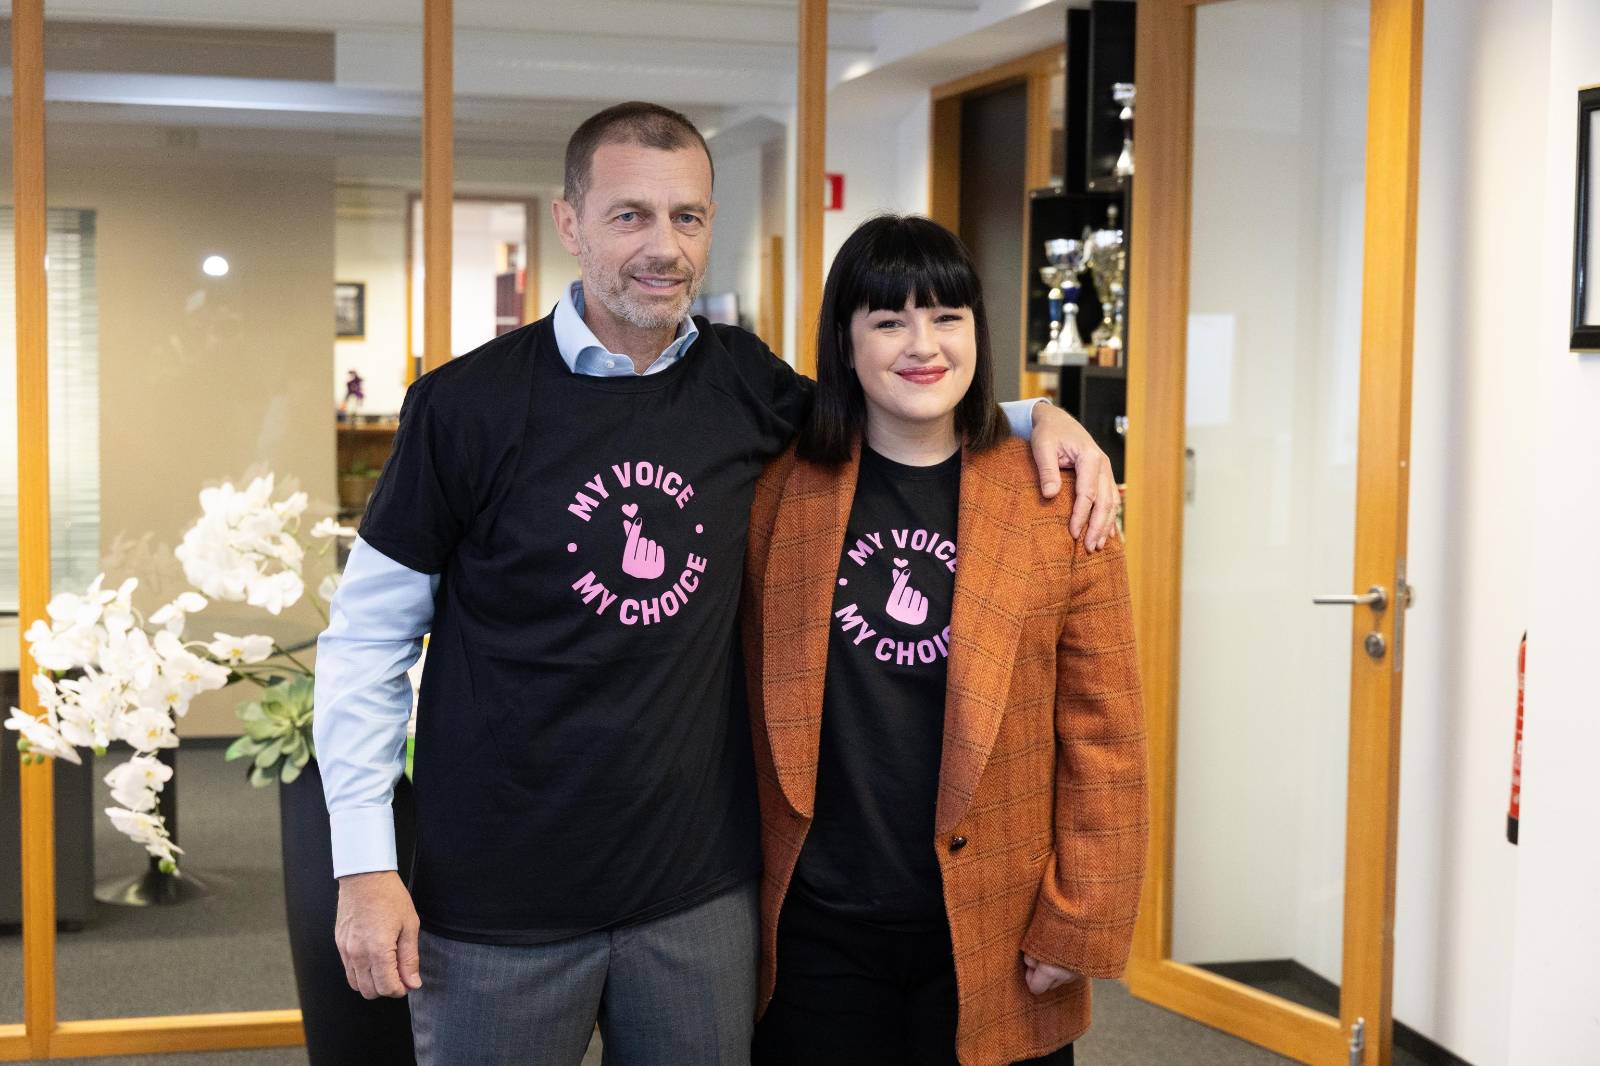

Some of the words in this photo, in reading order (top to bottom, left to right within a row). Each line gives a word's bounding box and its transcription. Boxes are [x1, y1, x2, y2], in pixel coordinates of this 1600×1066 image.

[567, 473, 610, 522] MY
[611, 461, 695, 510] VOICE
[847, 532, 884, 567] MY
[571, 570, 618, 616] MY
[619, 552, 708, 626] CHOICE
[834, 603, 877, 646] MY
